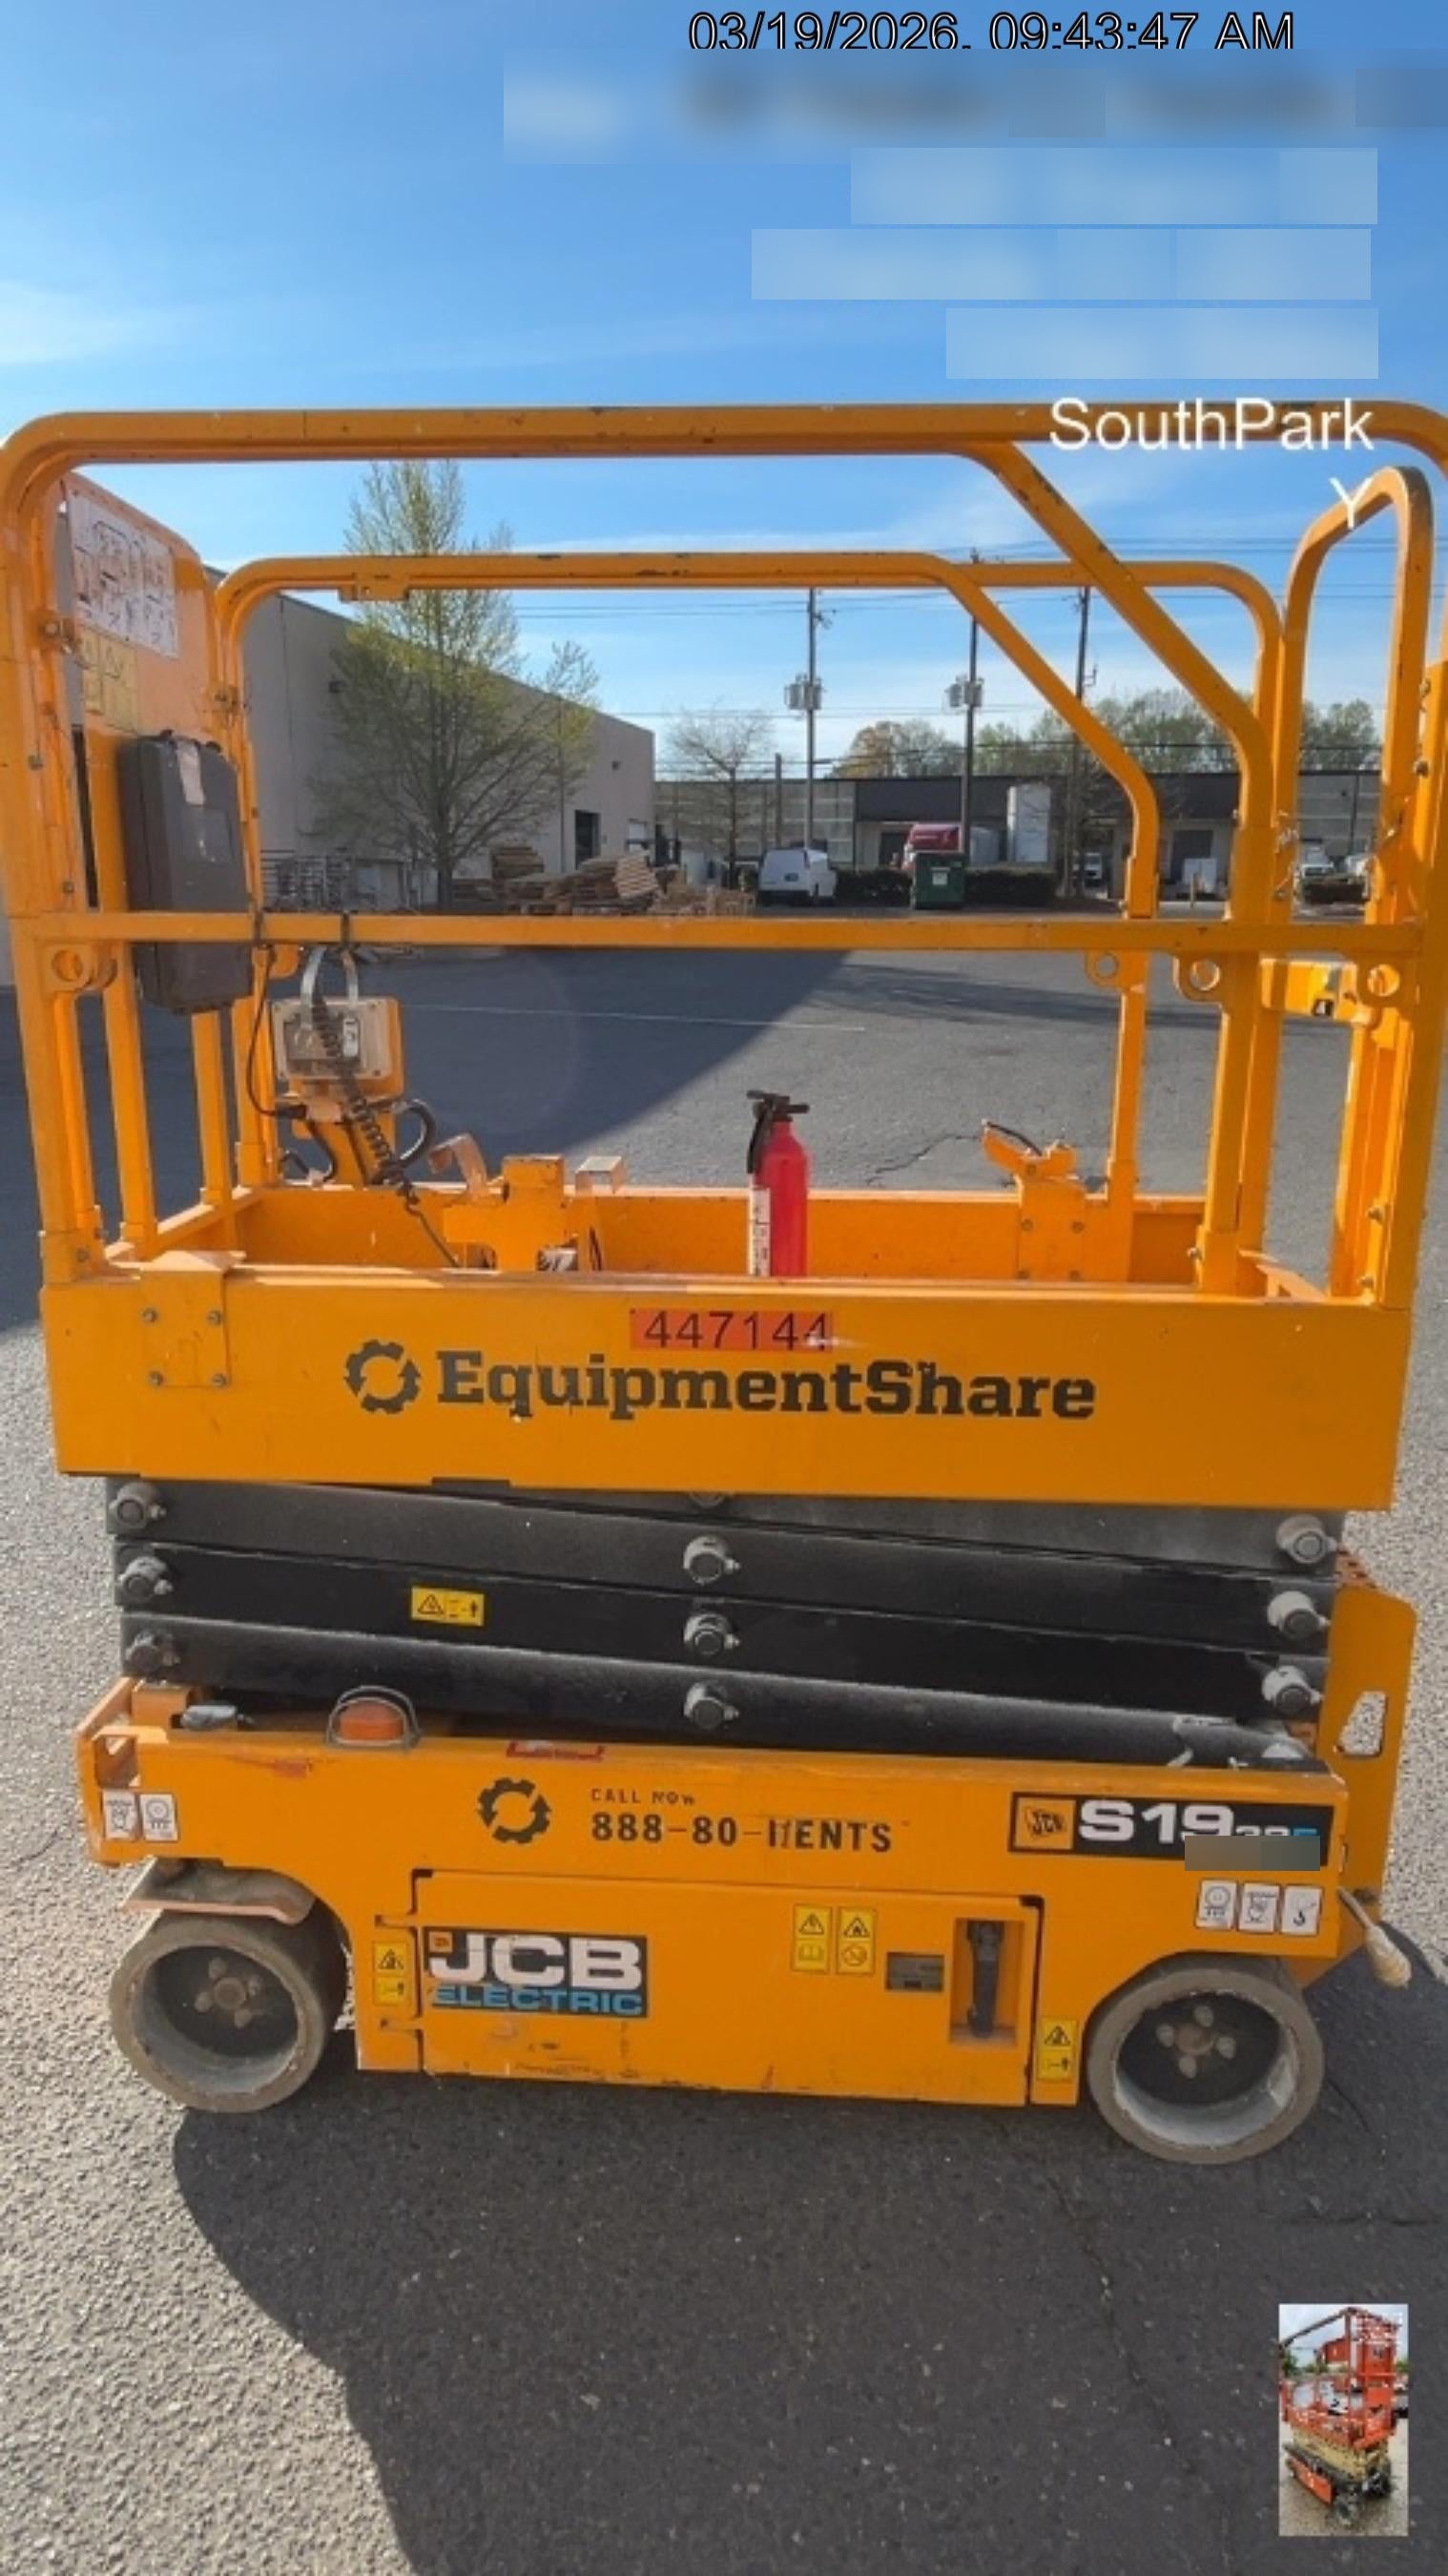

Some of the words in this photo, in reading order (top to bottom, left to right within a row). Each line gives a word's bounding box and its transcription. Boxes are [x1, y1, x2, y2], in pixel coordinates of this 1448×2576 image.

[644, 1311, 826, 1350] 447144
[437, 1350, 1095, 1420] EquipmentShare
[590, 1788, 641, 1803] CALL
[430, 1934, 642, 1990] JCB
[436, 1984, 642, 2016] ELECTRIC
